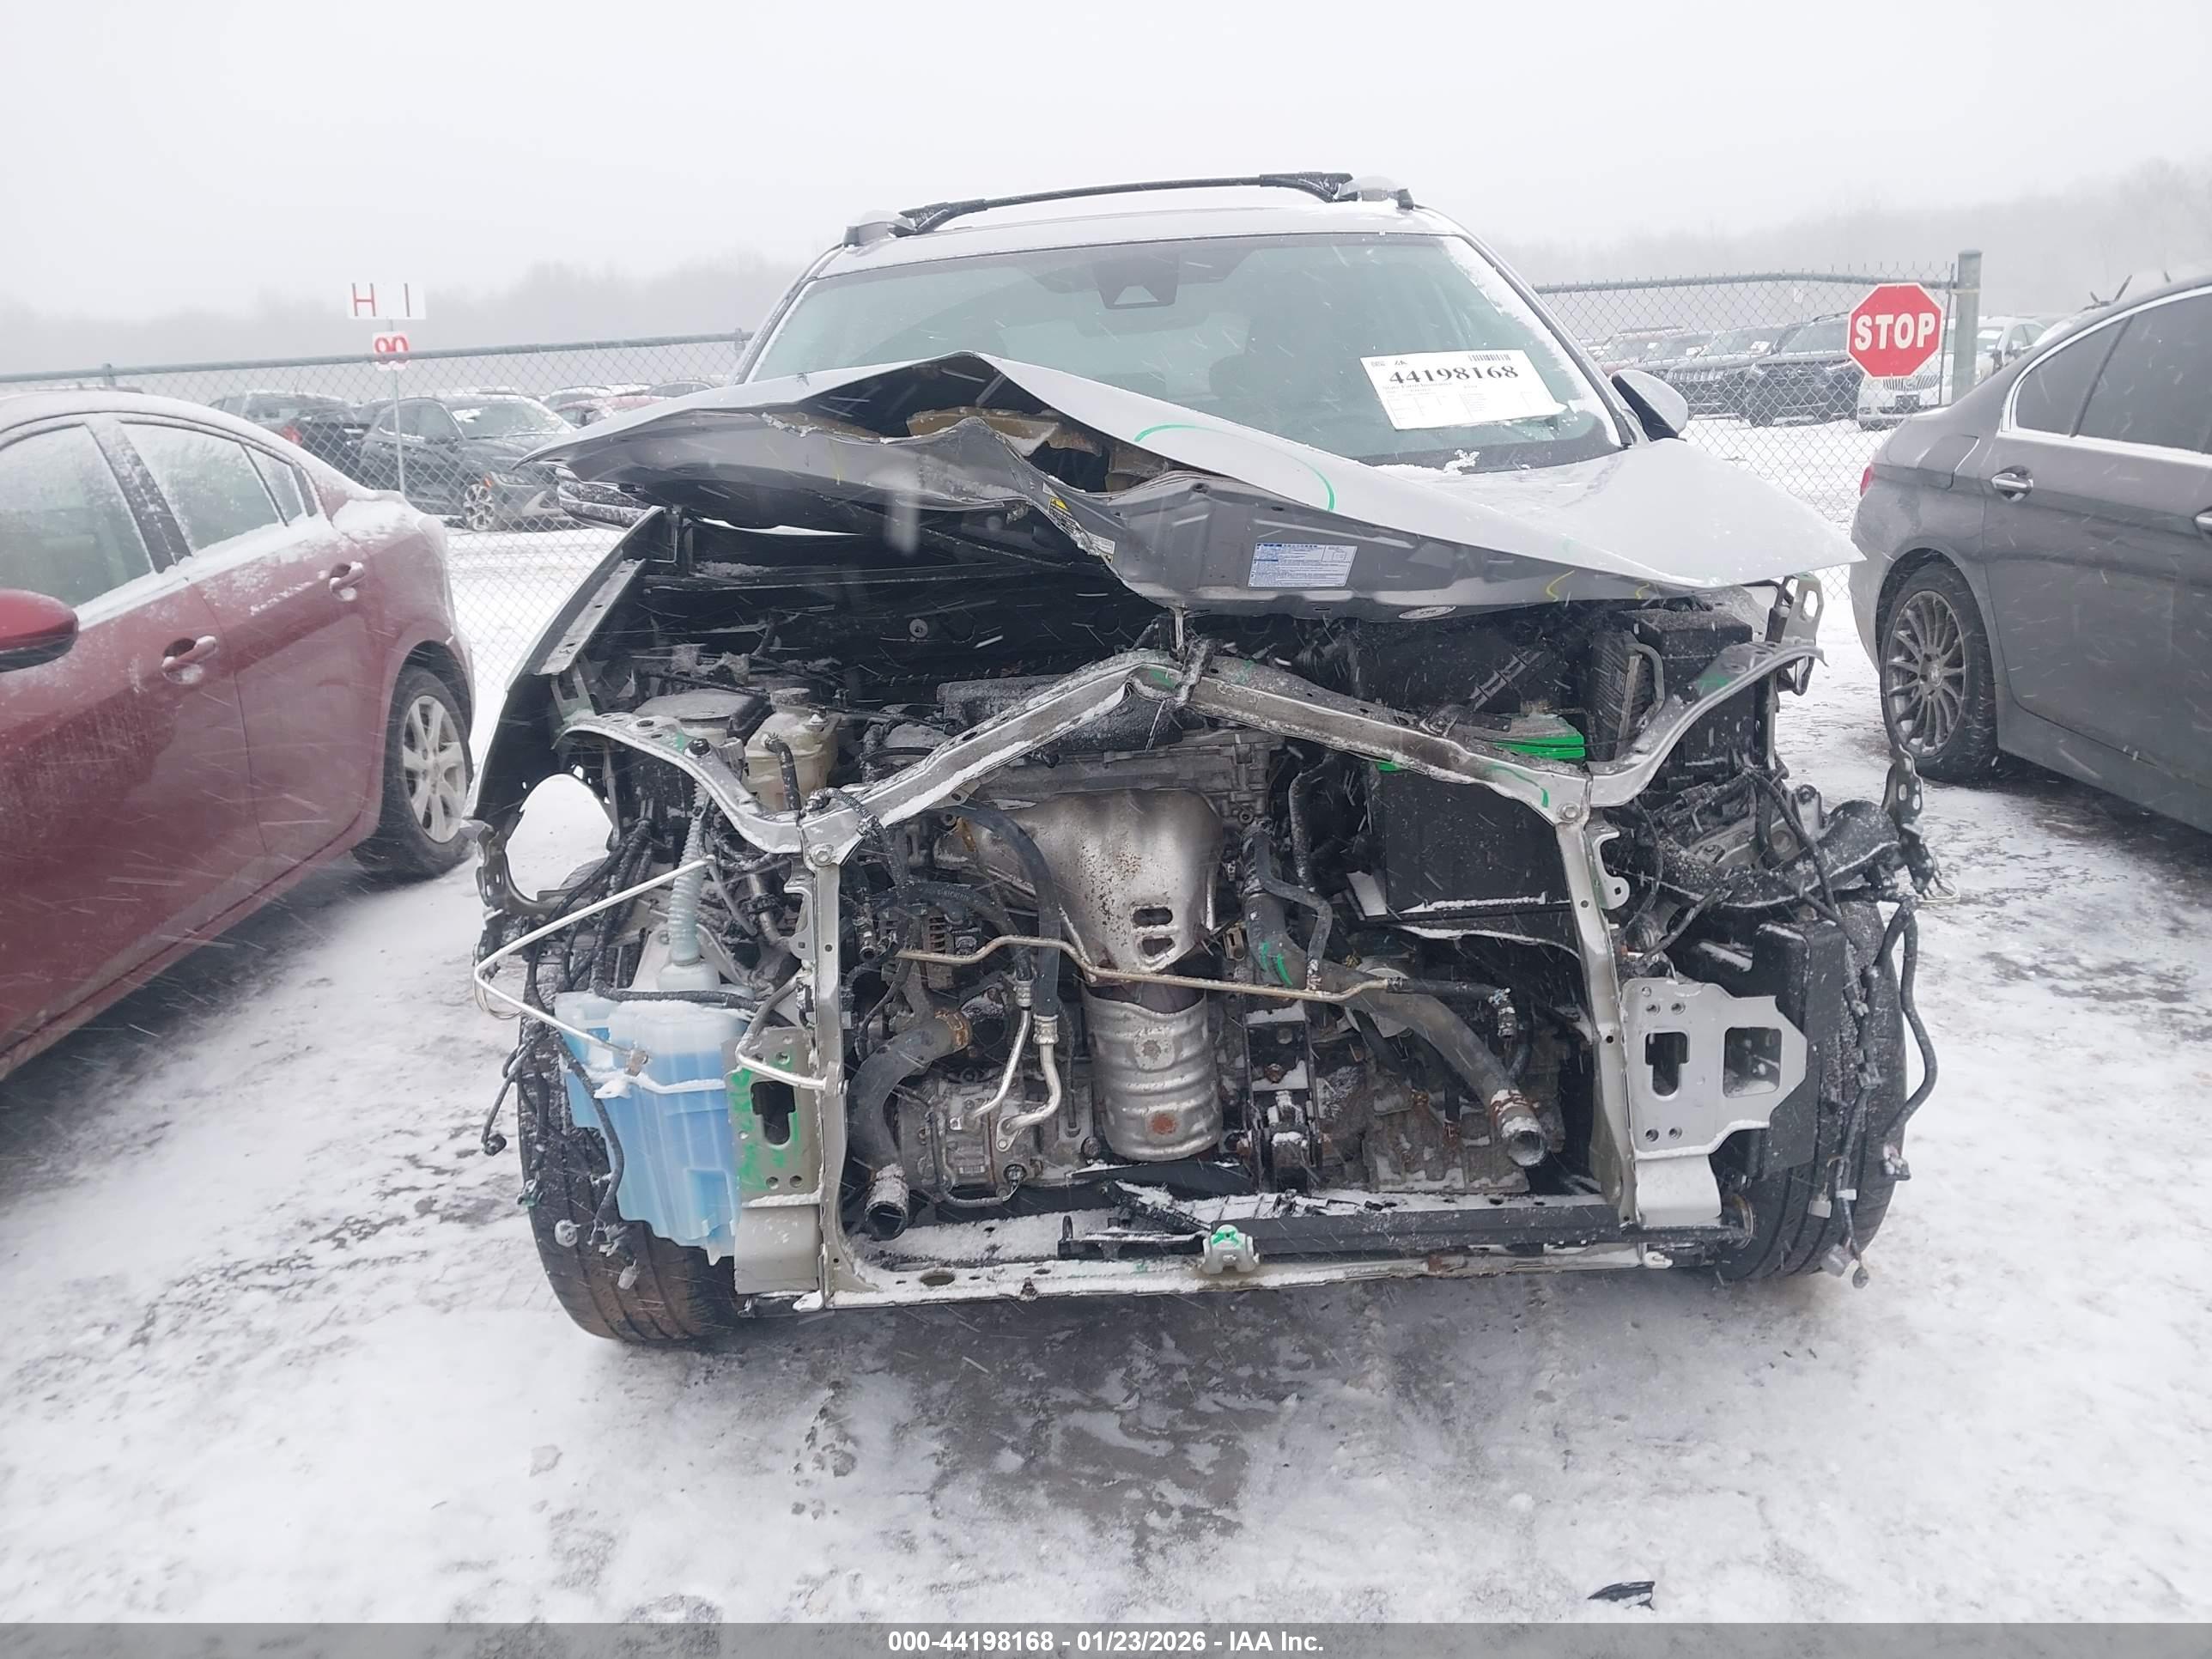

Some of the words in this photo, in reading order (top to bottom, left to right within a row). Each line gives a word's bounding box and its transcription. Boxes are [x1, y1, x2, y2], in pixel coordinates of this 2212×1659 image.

[351, 282, 376, 317] H
[1855, 313, 1936, 351] STOP
[1389, 365, 1519, 384] 44198168
